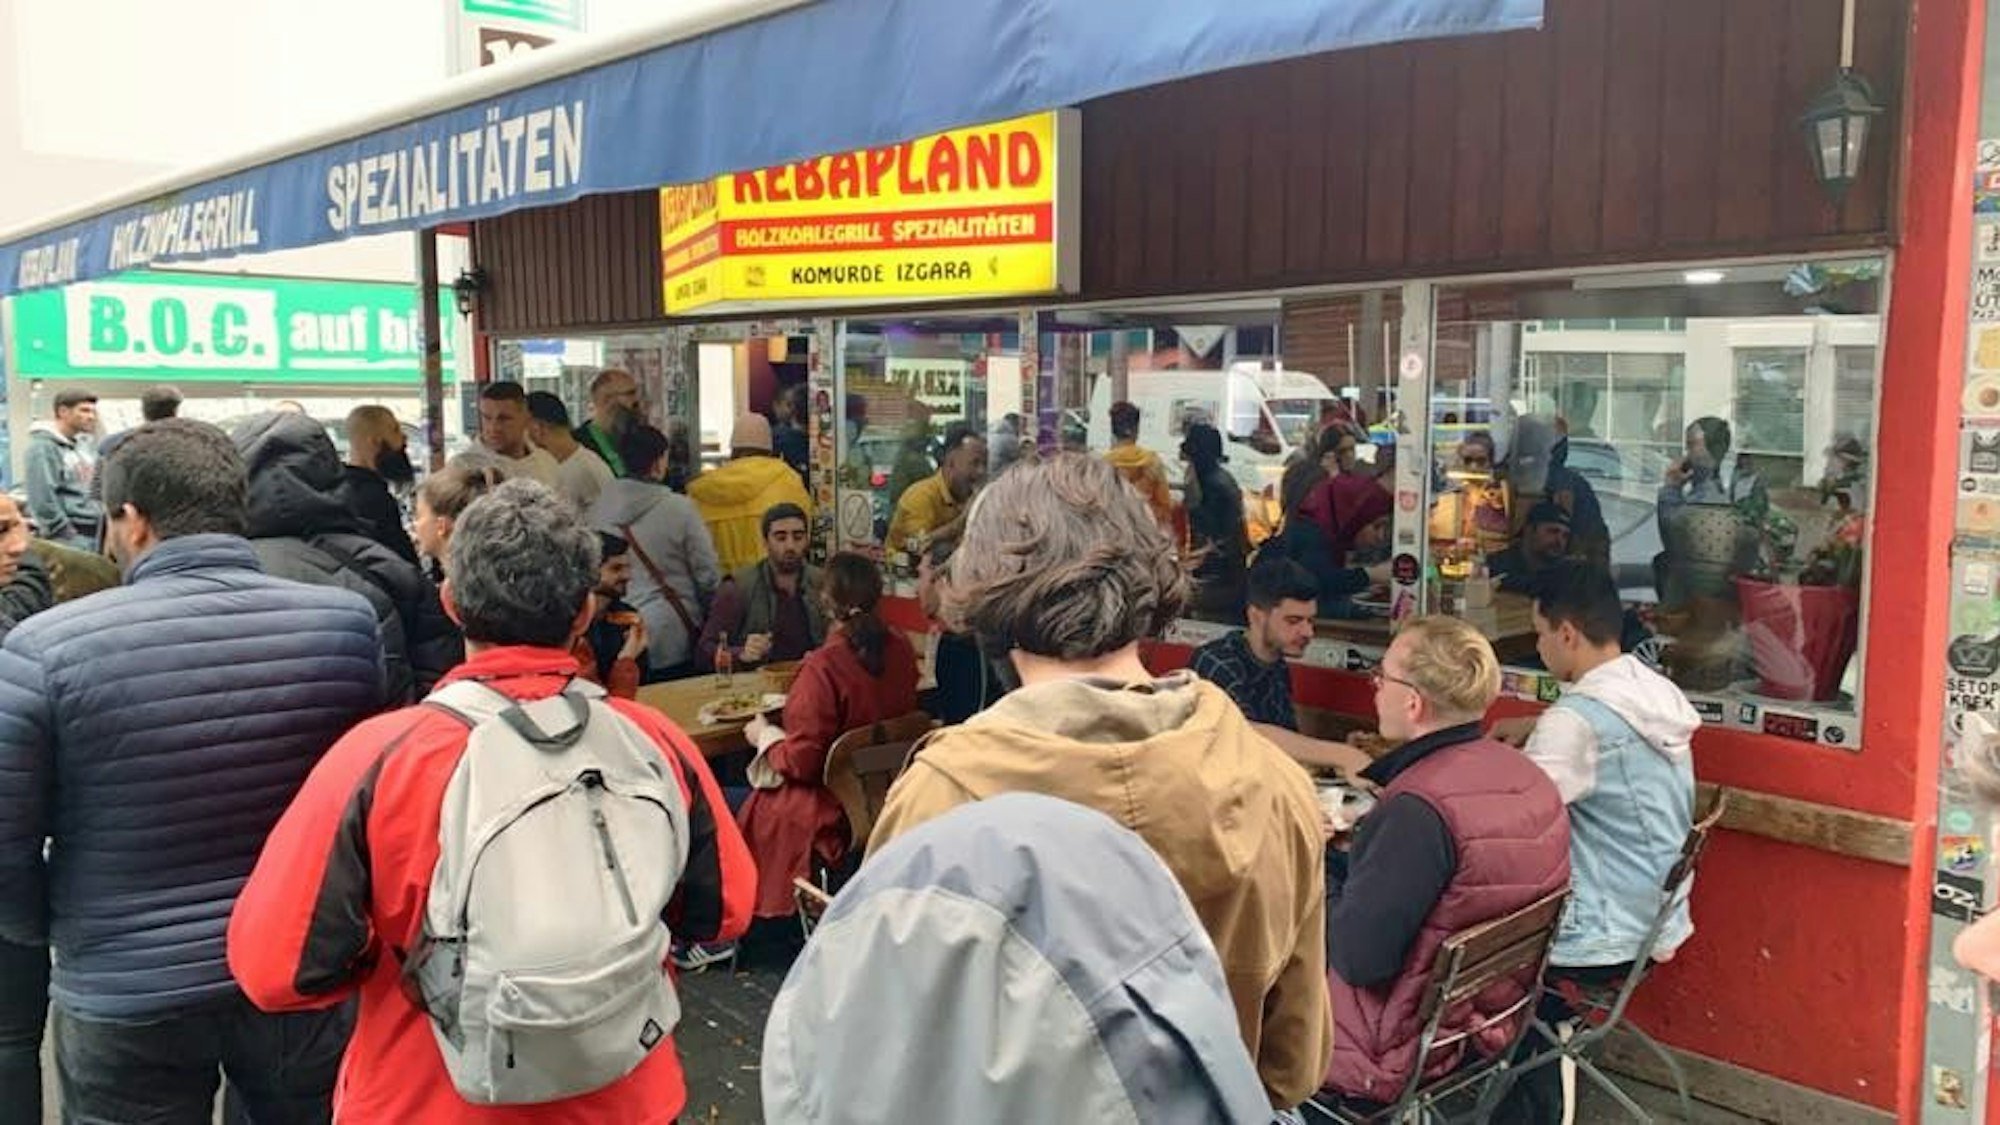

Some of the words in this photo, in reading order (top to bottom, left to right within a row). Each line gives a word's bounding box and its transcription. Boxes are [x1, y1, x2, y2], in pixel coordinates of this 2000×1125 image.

[327, 101, 583, 232] SPEZIALITÄTEN
[736, 221, 883, 248] HOLZKOHLEGRILL
[892, 212, 1036, 242] SPEZIALITÄTEN
[897, 261, 971, 281] IZGARA
[90, 295, 265, 355] B.O.C.
[289, 306, 367, 353] auf
